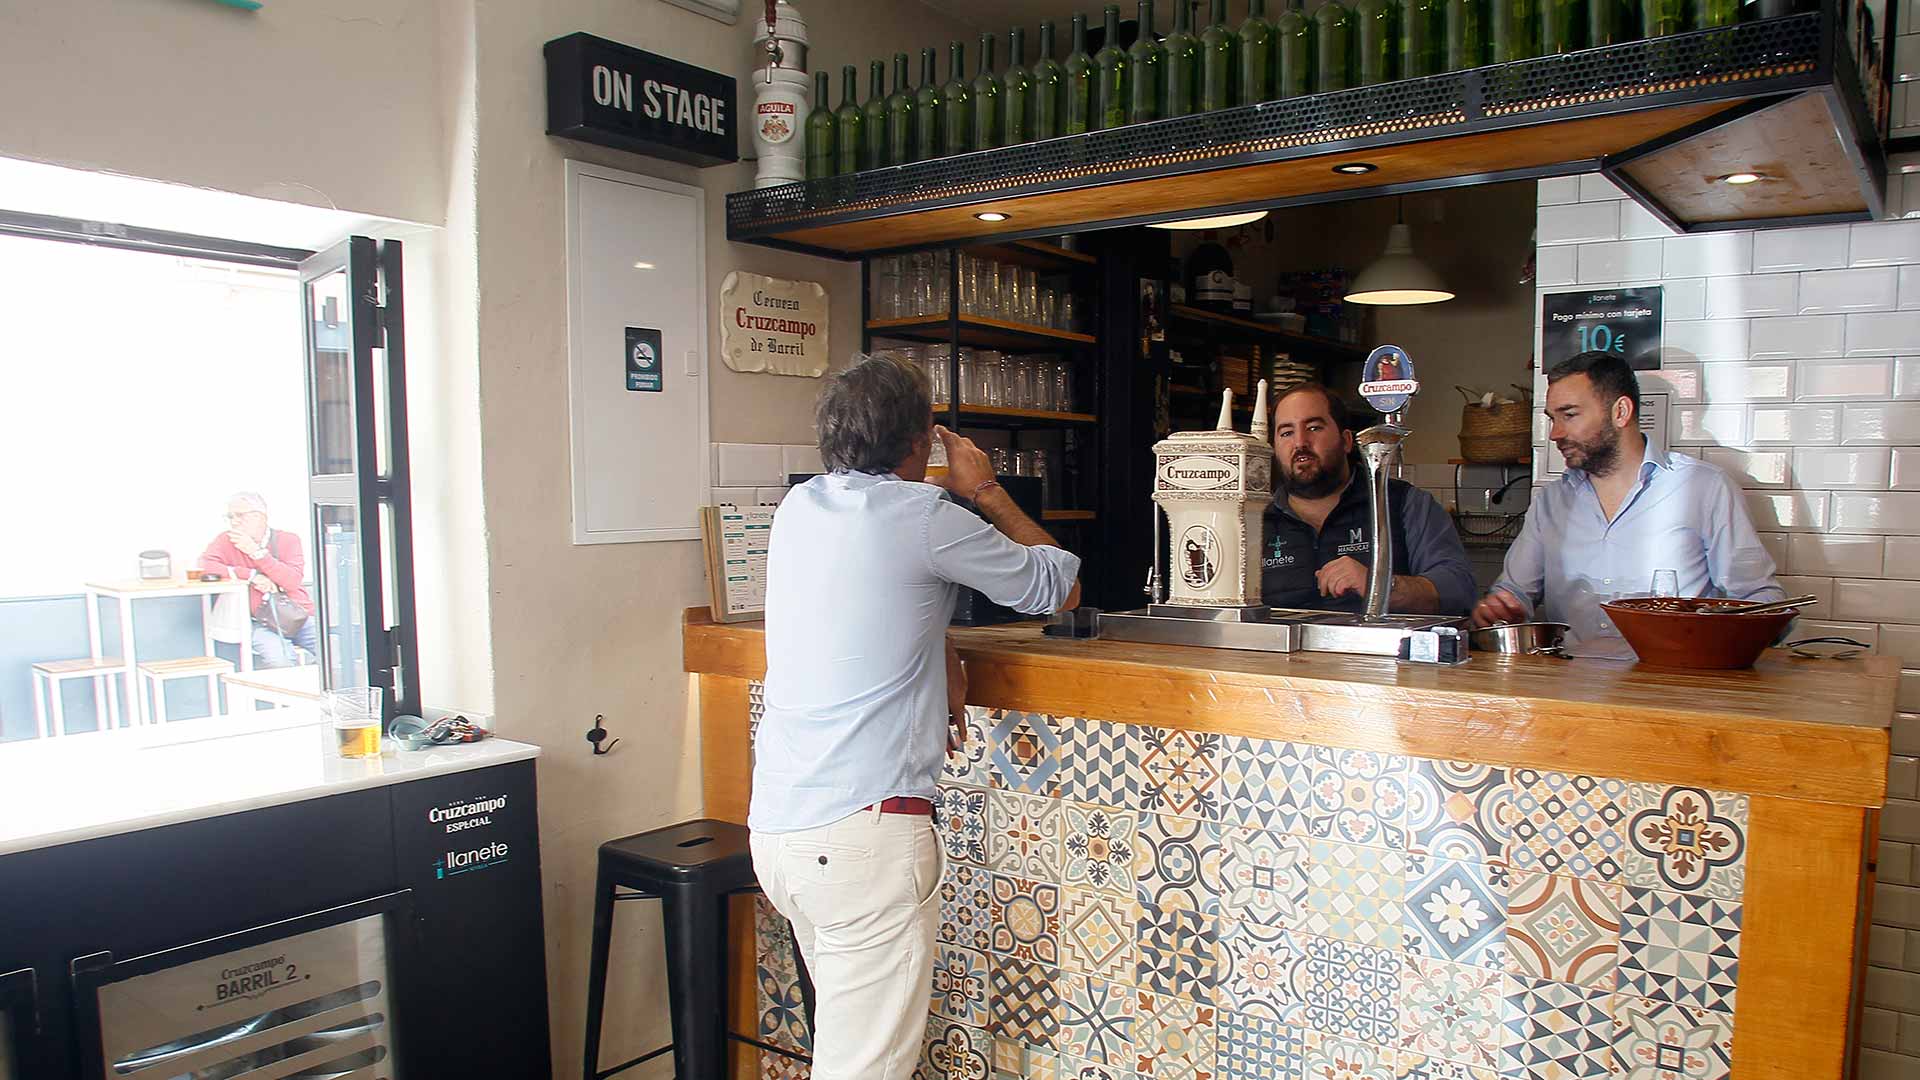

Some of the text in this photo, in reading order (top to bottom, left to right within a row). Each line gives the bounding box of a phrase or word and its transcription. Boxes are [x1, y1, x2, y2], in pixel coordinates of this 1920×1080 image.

[593, 65, 725, 136] ON STAGE
[735, 306, 816, 340] Cruzcampo
[1552, 312, 1574, 323] Pago
[1623, 308, 1653, 318] tarjeta
[751, 337, 805, 356] de Barril
[1363, 383, 1412, 394] Cruzcampo
[1167, 465, 1231, 482] Cruzcampo
[1350, 527, 1362, 543] M
[429, 796, 508, 823] Cruzcampo
[446, 816, 492, 834] ESPECIAL
[447, 841, 508, 869] llanete
[221, 955, 286, 980] Cruzcampo
[216, 964, 298, 1001] BARRIL 2
